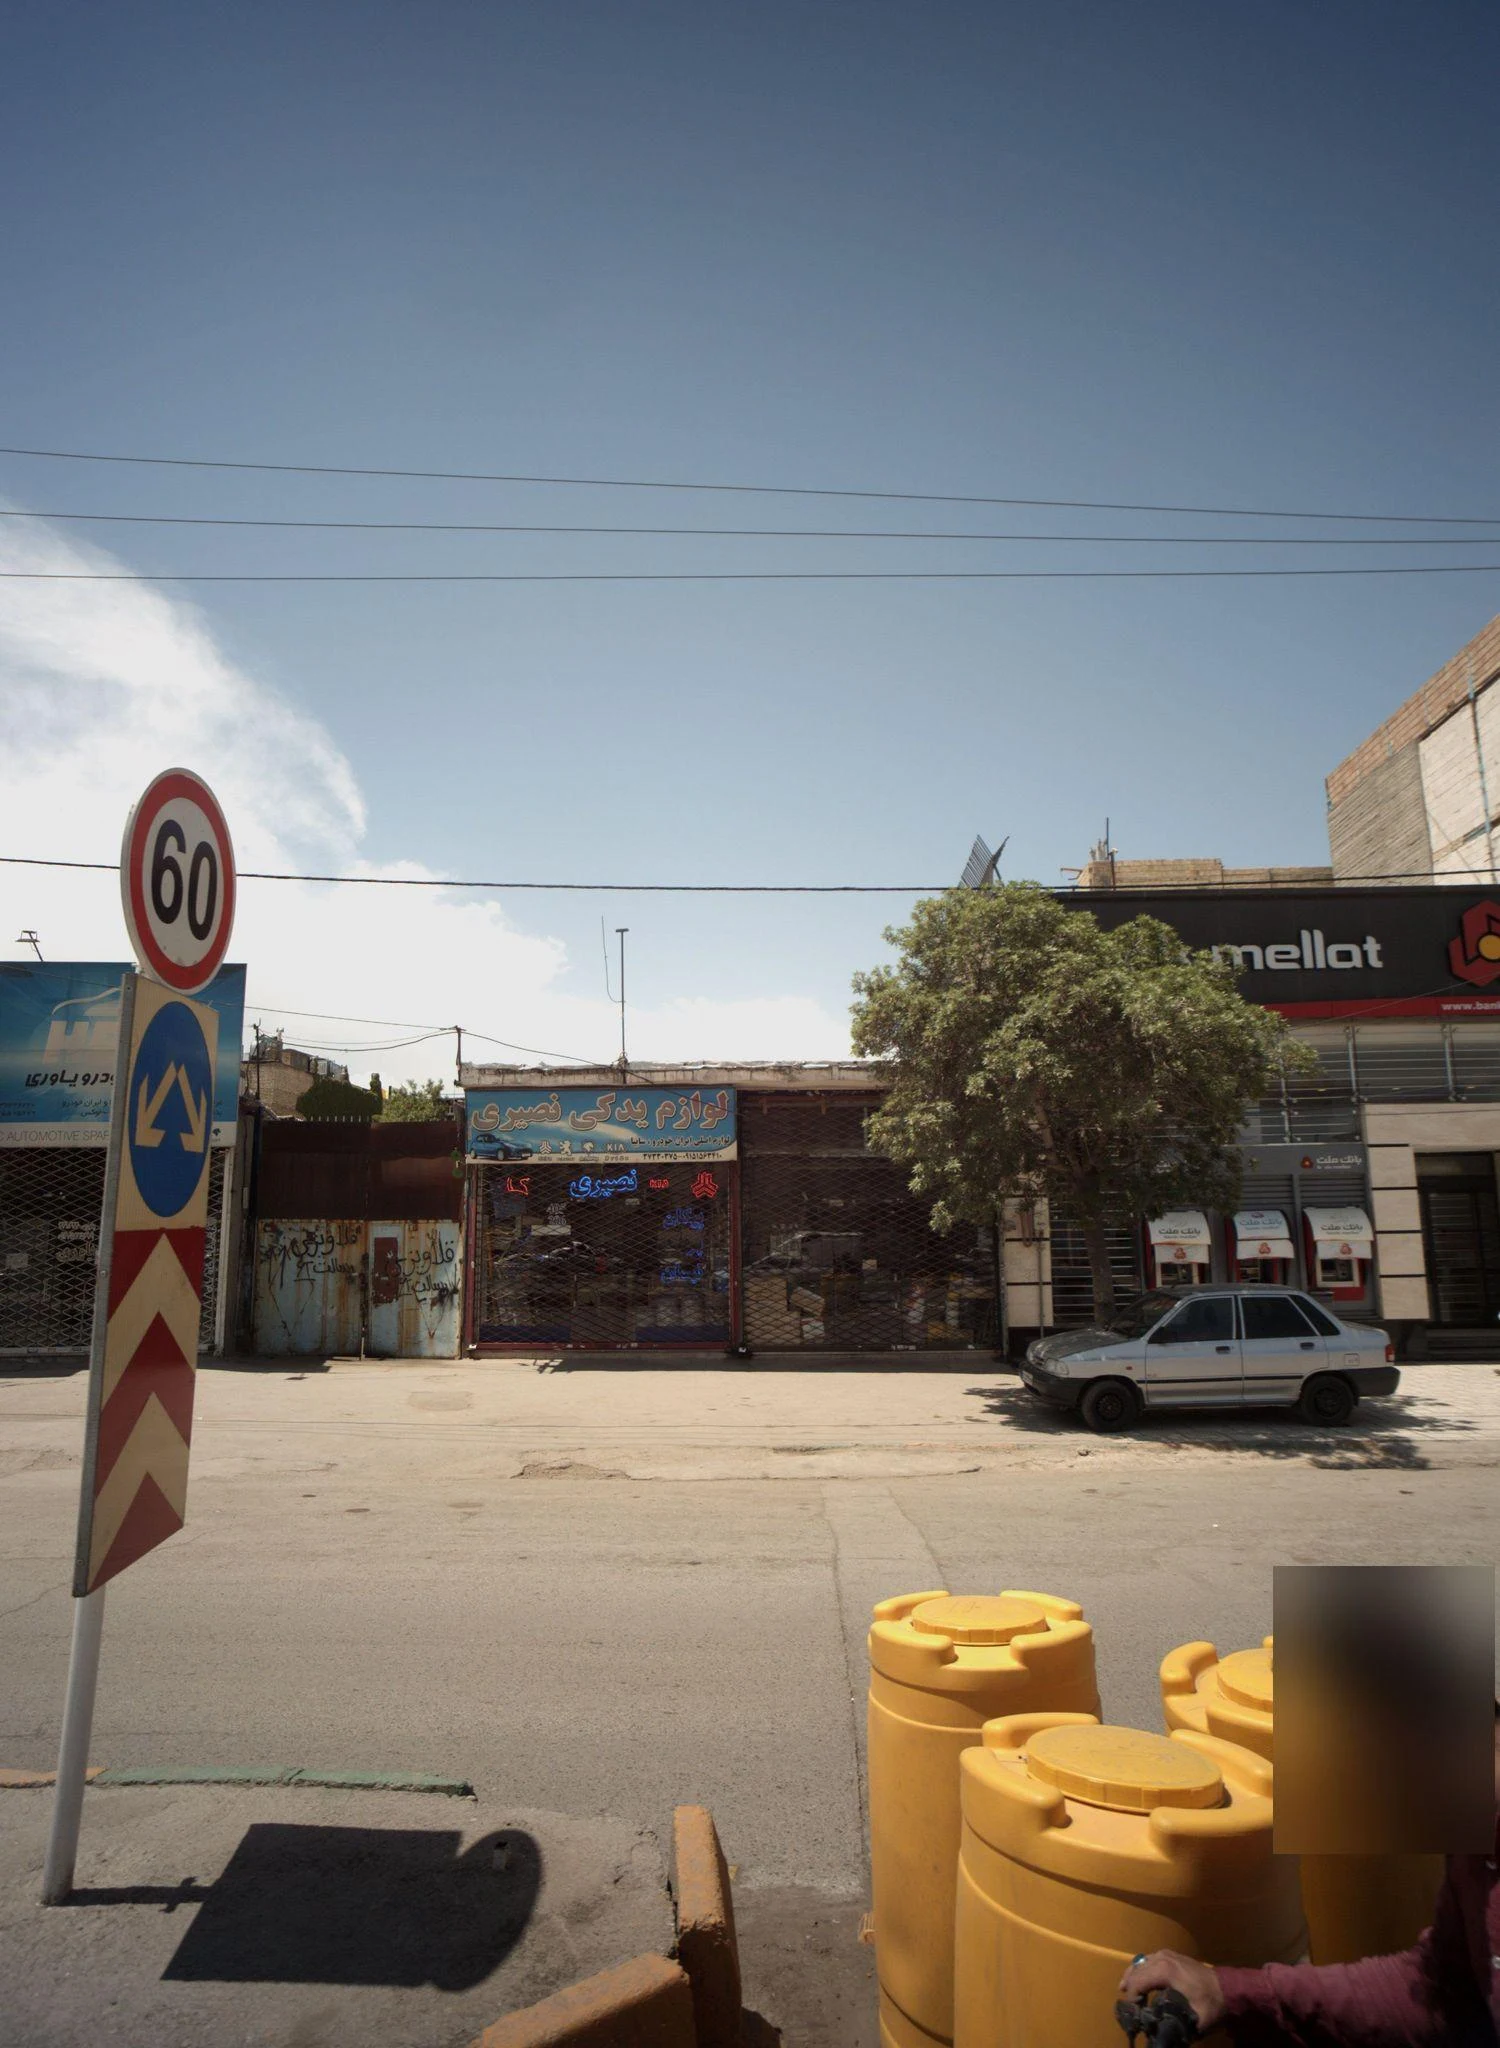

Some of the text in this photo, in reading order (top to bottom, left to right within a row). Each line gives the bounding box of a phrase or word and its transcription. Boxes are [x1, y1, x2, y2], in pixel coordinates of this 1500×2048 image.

[151, 819, 217, 941] 60
[1211, 929, 1384, 970] mellat
[25, 1069, 79, 1088] یاوری
[472, 1090, 729, 1131] لوازم یدکی نصیری
[7, 1130, 80, 1142] AUTOMOTIVE
[675, 1135, 692, 1146] ایران
[712, 1135, 730, 1146] لوازم
[607, 1143, 625, 1152] KIA
[1316, 1154, 1362, 1166] بانک ملت
[569, 1169, 638, 1197] نصیری
